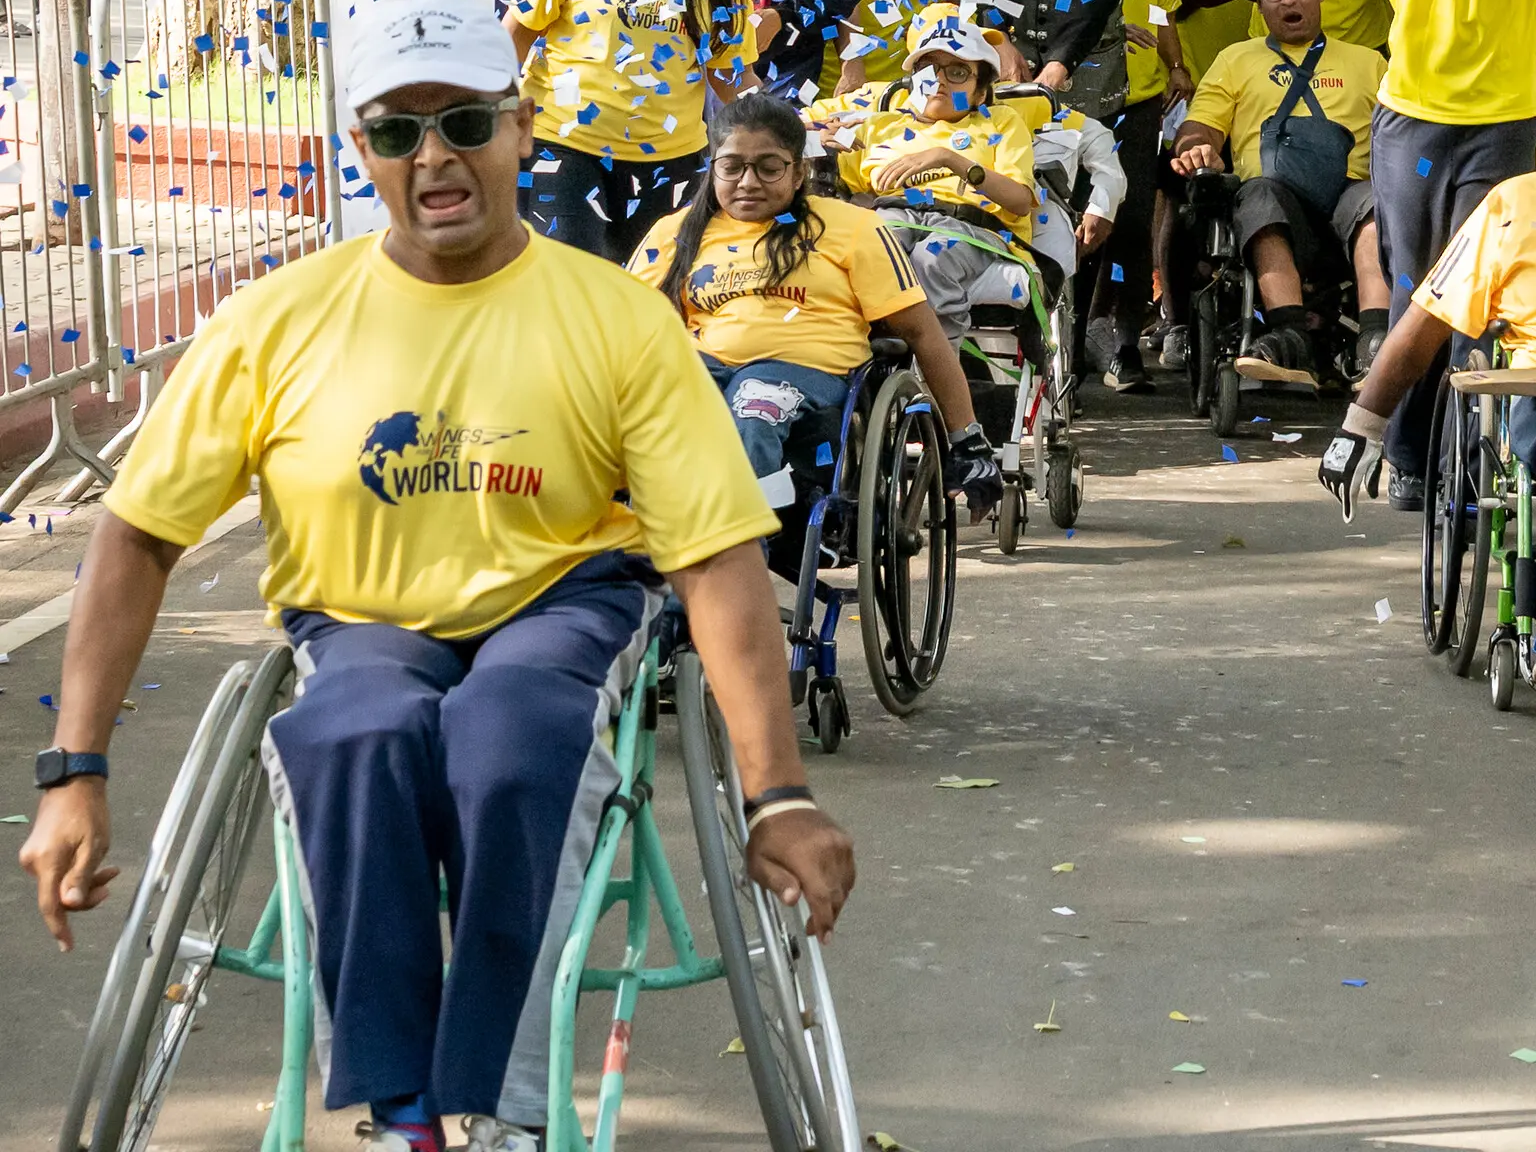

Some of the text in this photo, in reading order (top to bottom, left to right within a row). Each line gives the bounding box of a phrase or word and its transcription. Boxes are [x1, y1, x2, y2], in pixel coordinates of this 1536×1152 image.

[1320, 77, 1343, 88] RUN
[418, 427, 483, 447] WINGS
[393, 461, 543, 497] WORLD RUN
